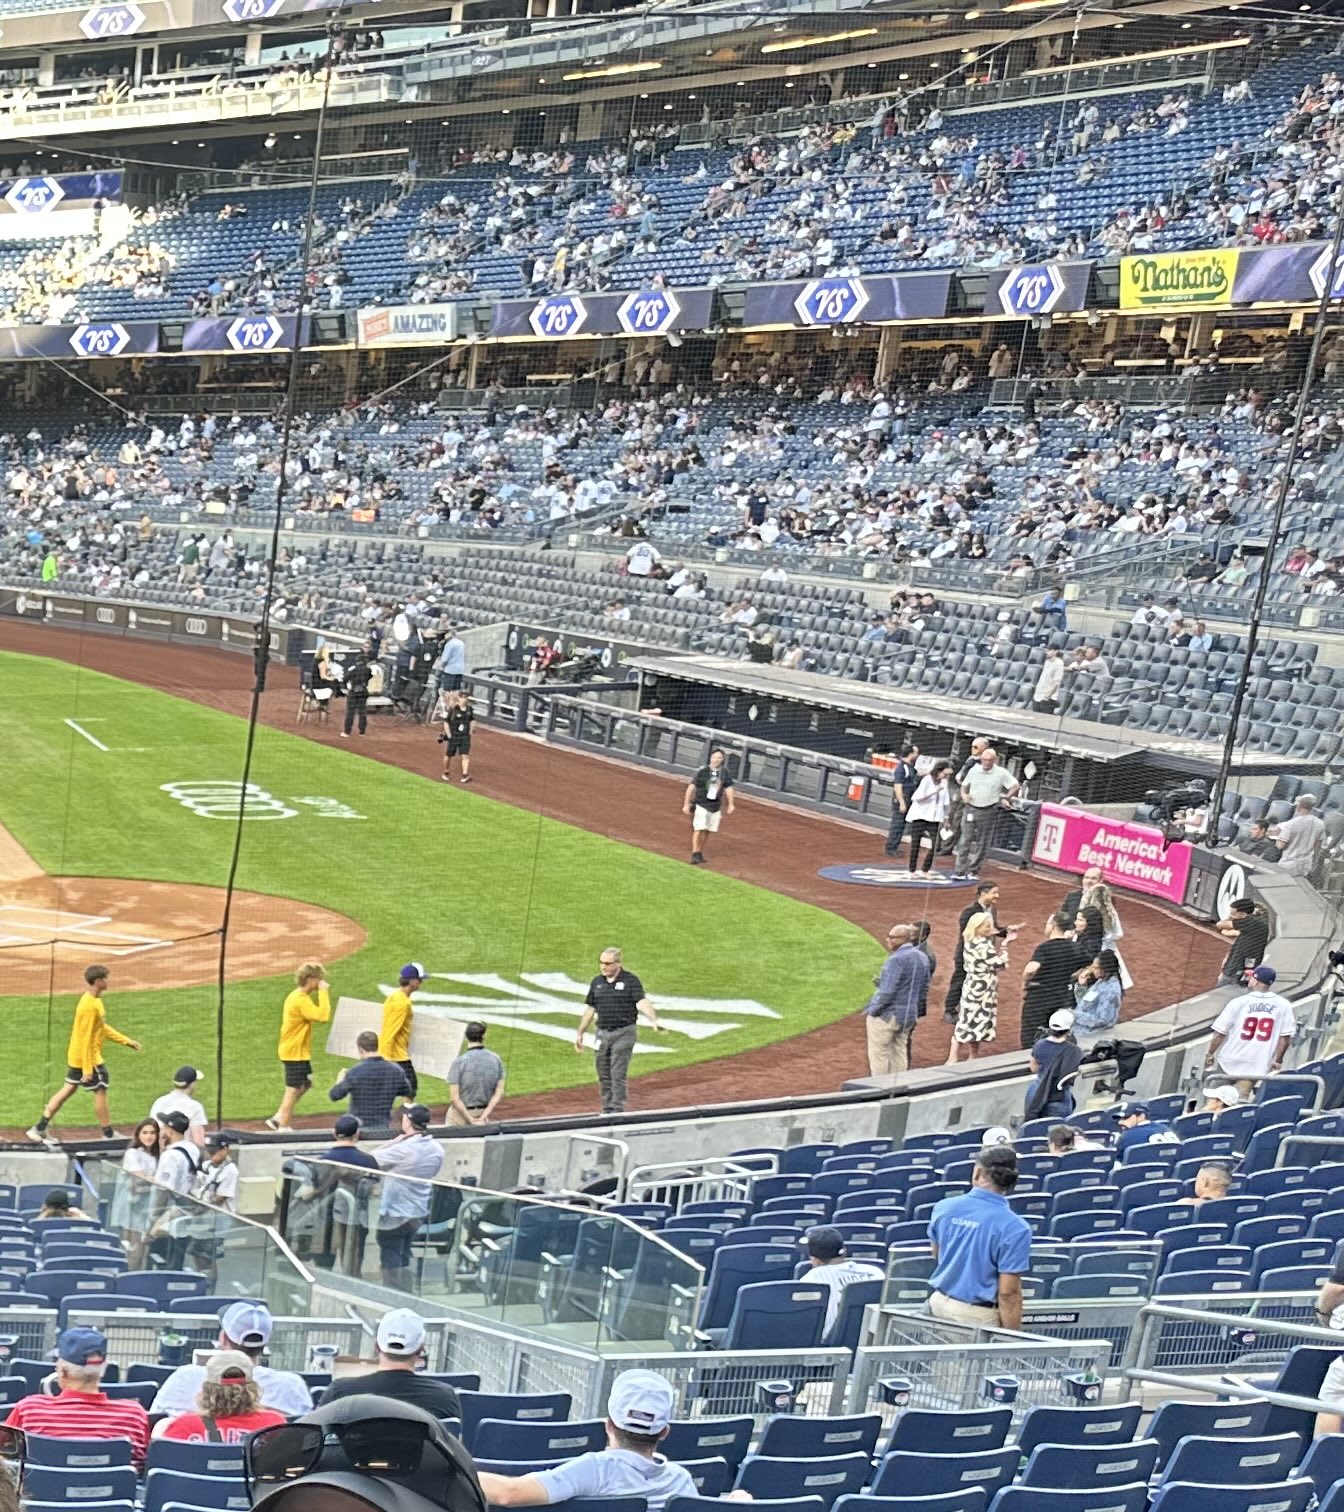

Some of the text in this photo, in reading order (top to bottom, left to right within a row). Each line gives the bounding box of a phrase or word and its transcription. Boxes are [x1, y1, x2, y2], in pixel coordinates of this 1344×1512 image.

[1131, 256, 1229, 296] Nathan's
[1092, 827, 1169, 863] America's
[1077, 844, 1174, 887] Best Network
[1240, 1017, 1274, 1041] 99
